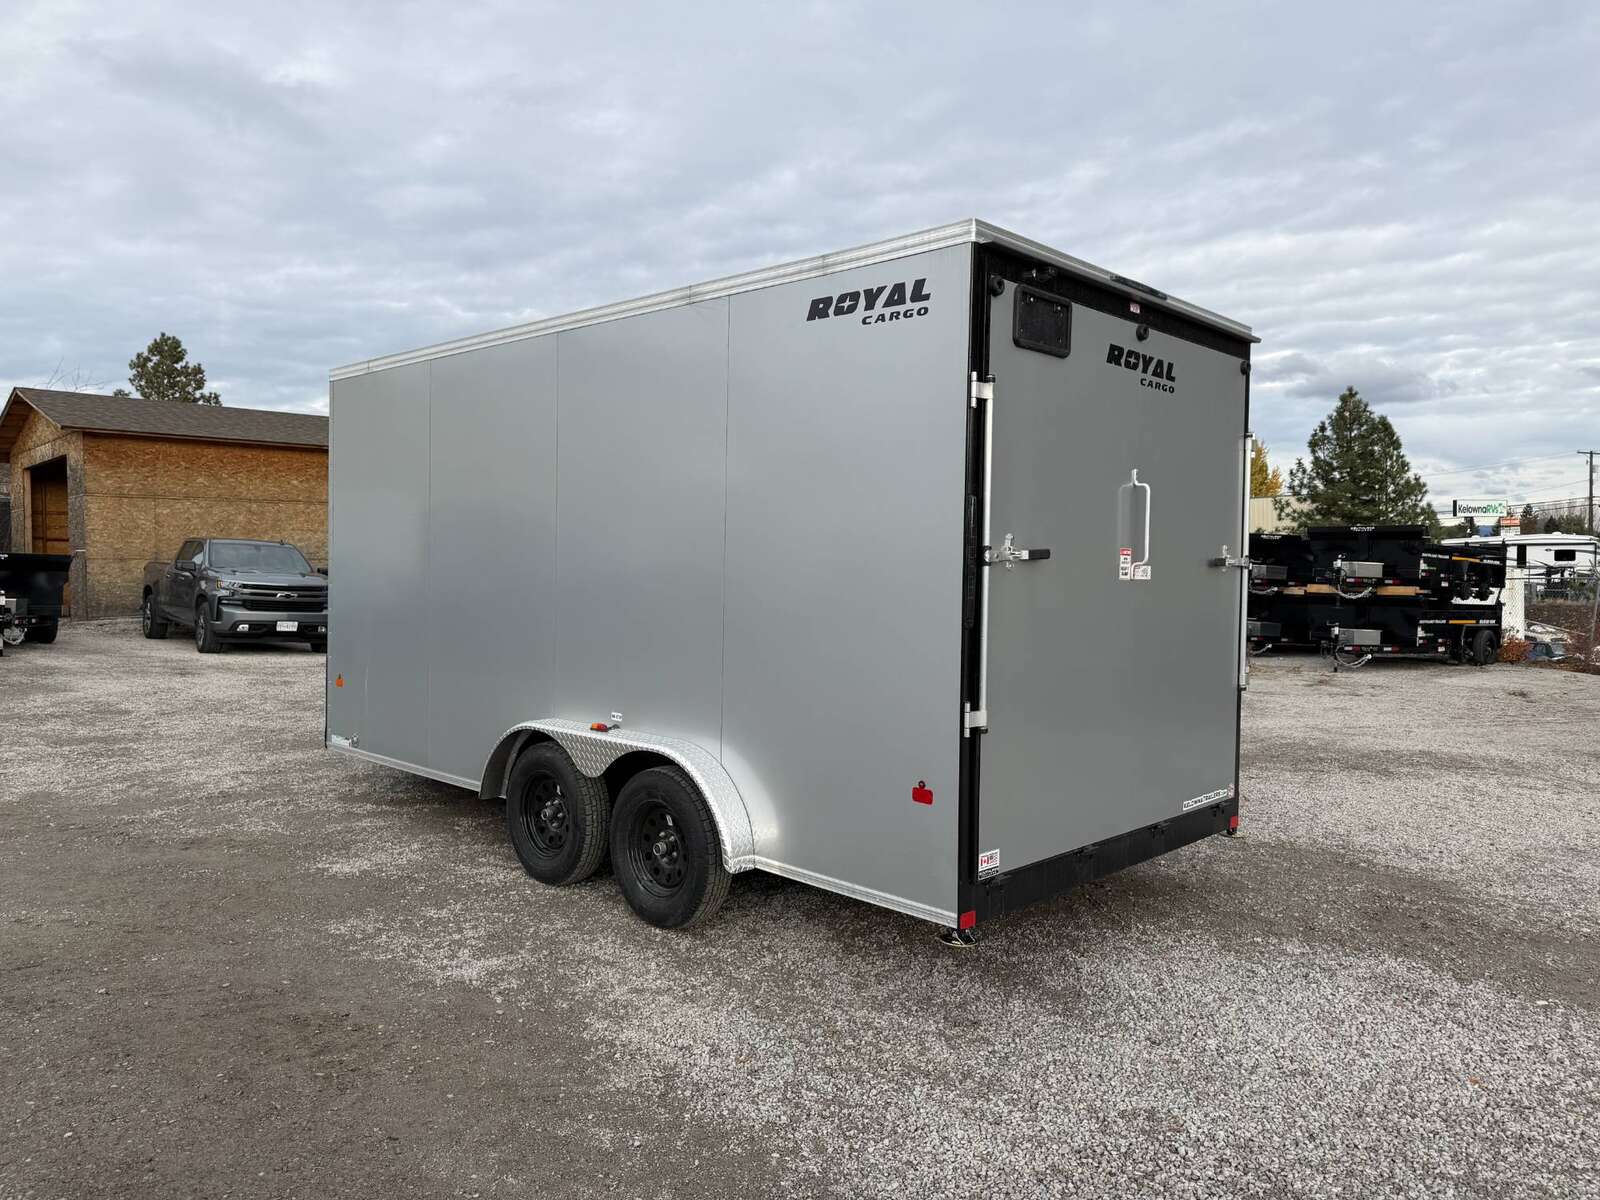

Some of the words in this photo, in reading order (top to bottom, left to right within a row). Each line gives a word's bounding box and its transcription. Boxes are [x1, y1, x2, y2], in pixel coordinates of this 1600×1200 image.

[806, 278, 932, 322] ROYAL
[861, 306, 929, 325] CARGO
[1106, 343, 1176, 382] ROYAL
[1140, 378, 1175, 394] CARGO
[1457, 503, 1499, 514] KelownaRVs
